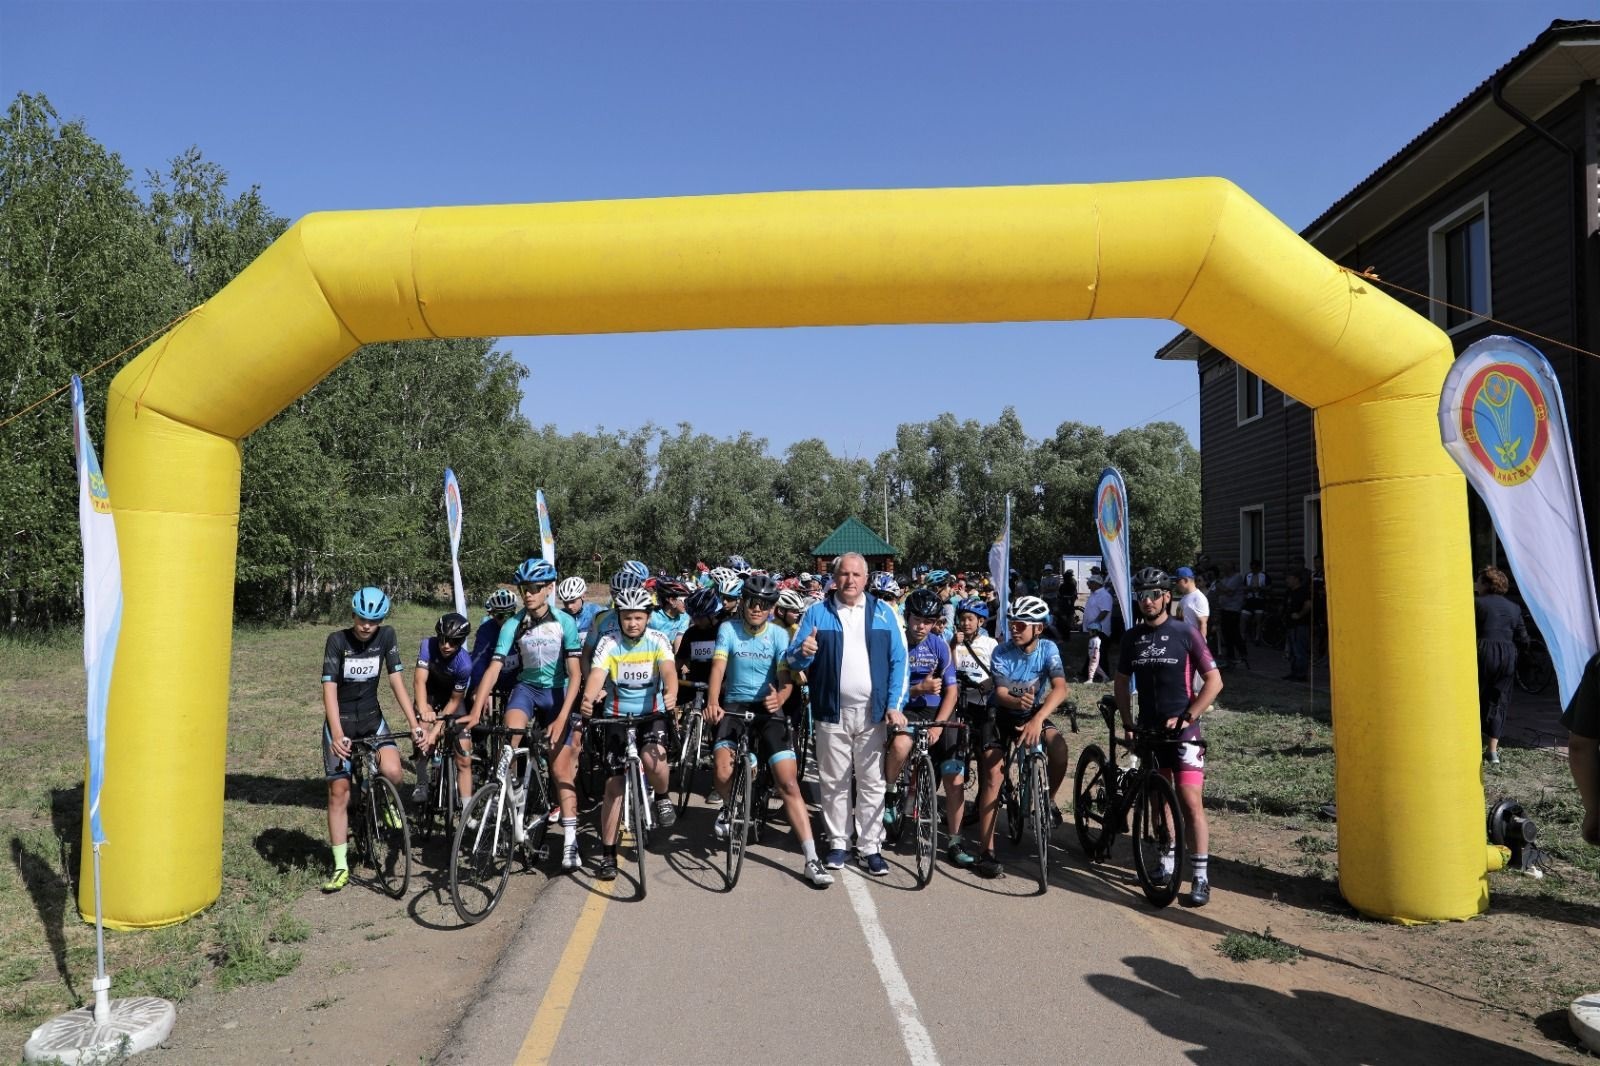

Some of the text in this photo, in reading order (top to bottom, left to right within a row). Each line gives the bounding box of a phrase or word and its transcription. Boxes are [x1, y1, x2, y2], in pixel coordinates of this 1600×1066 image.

[694, 647, 712, 656] 0056
[734, 651, 774, 660] ASTANA
[350, 665, 374, 675] 0027
[623, 671, 649, 681] 0196
